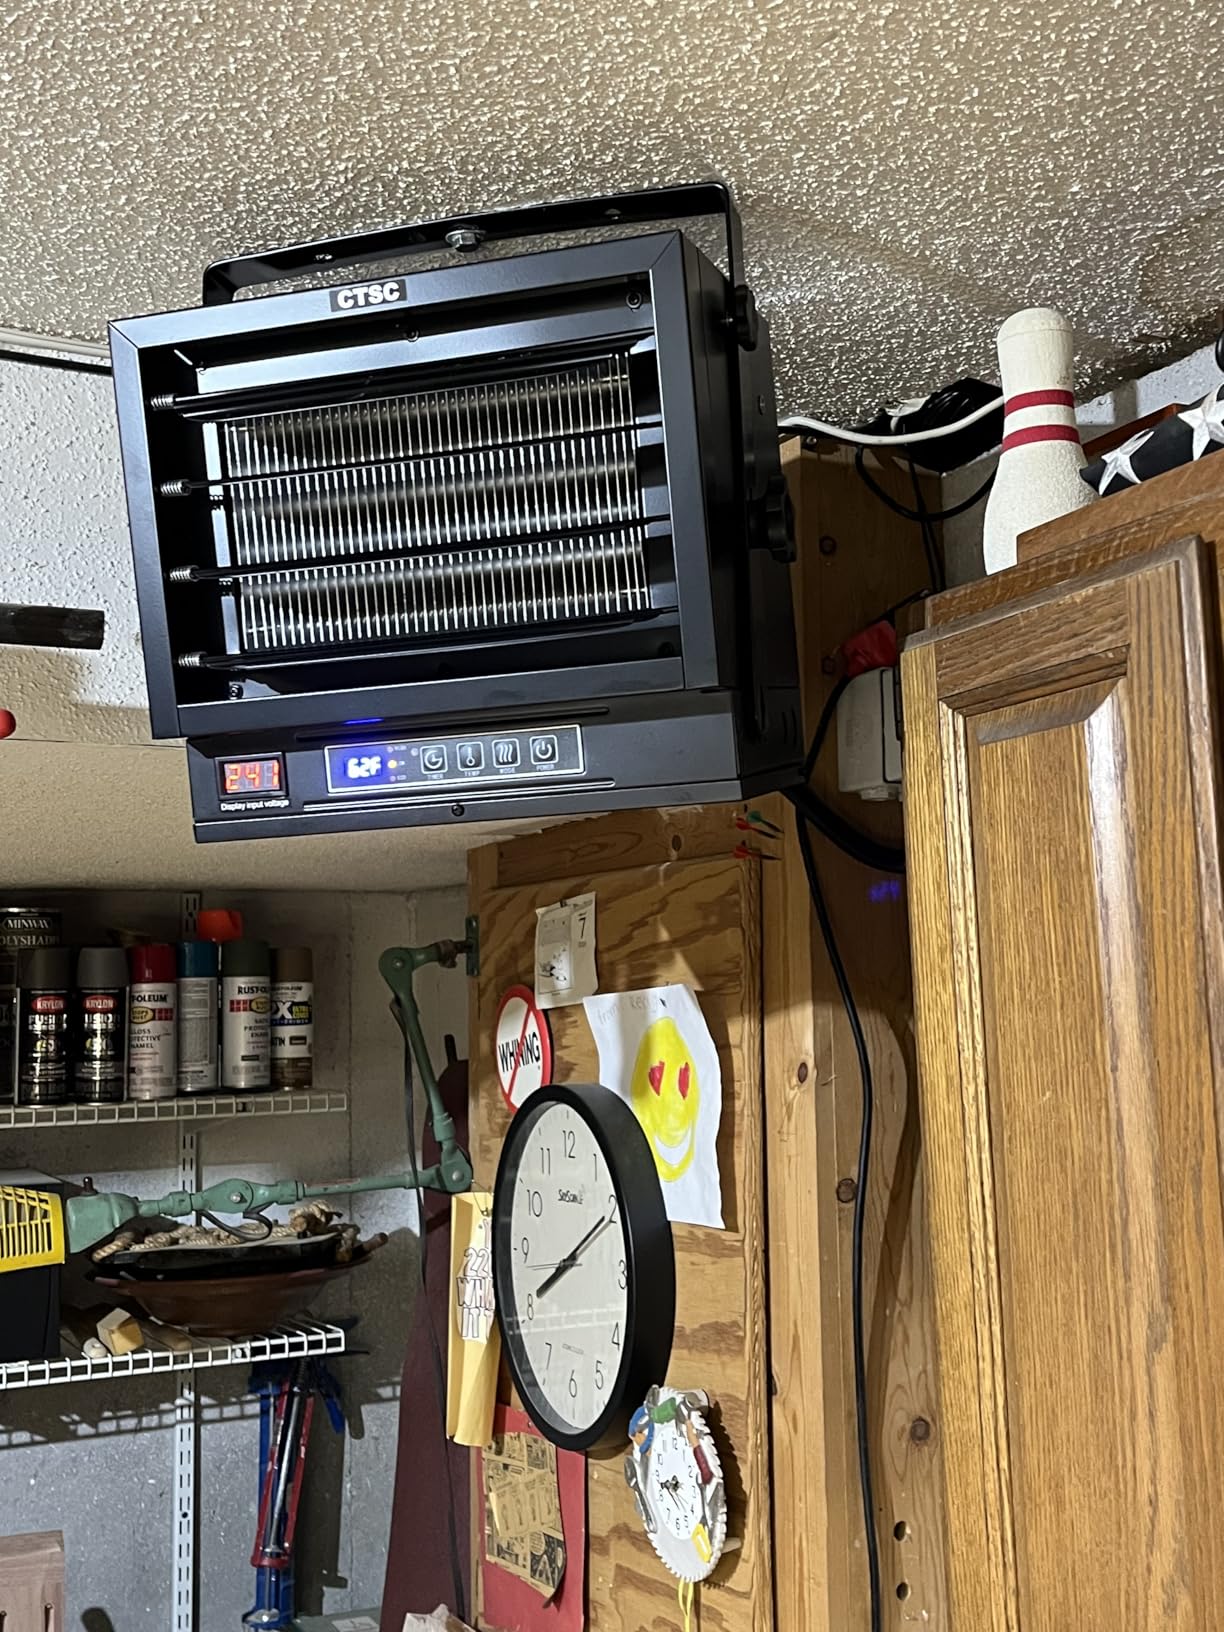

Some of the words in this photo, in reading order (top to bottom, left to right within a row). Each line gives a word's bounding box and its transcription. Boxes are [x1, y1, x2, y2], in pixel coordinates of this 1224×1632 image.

[337, 281, 401, 309] CTSC
[225, 760, 280, 790] 241
[347, 755, 382, 779] 62F
[220, 802, 246, 811] Display
[246, 801, 264, 810] input
[264, 799, 290, 808] voltage
[578, 917, 587, 940] 7
[36, 999, 65, 1010] KRYLON
[85, 999, 114, 1009] KRYLON
[498, 1032, 540, 1072] WHINING
[562, 1130, 576, 1159] 12
[540, 1147, 551, 1176] 11
[593, 1153, 598, 1182] 1
[526, 1189, 543, 1218] 10
[608, 1194, 617, 1224] 2
[521, 1237, 529, 1264] 9
[618, 1259, 627, 1290] 3
[527, 1293, 534, 1321] 8
[611, 1322, 620, 1352] 4
[545, 1342, 552, 1370] 7
[568, 1370, 577, 1398] 6
[595, 1360, 604, 1390] 5
[687, 1465, 693, 1478] 2
